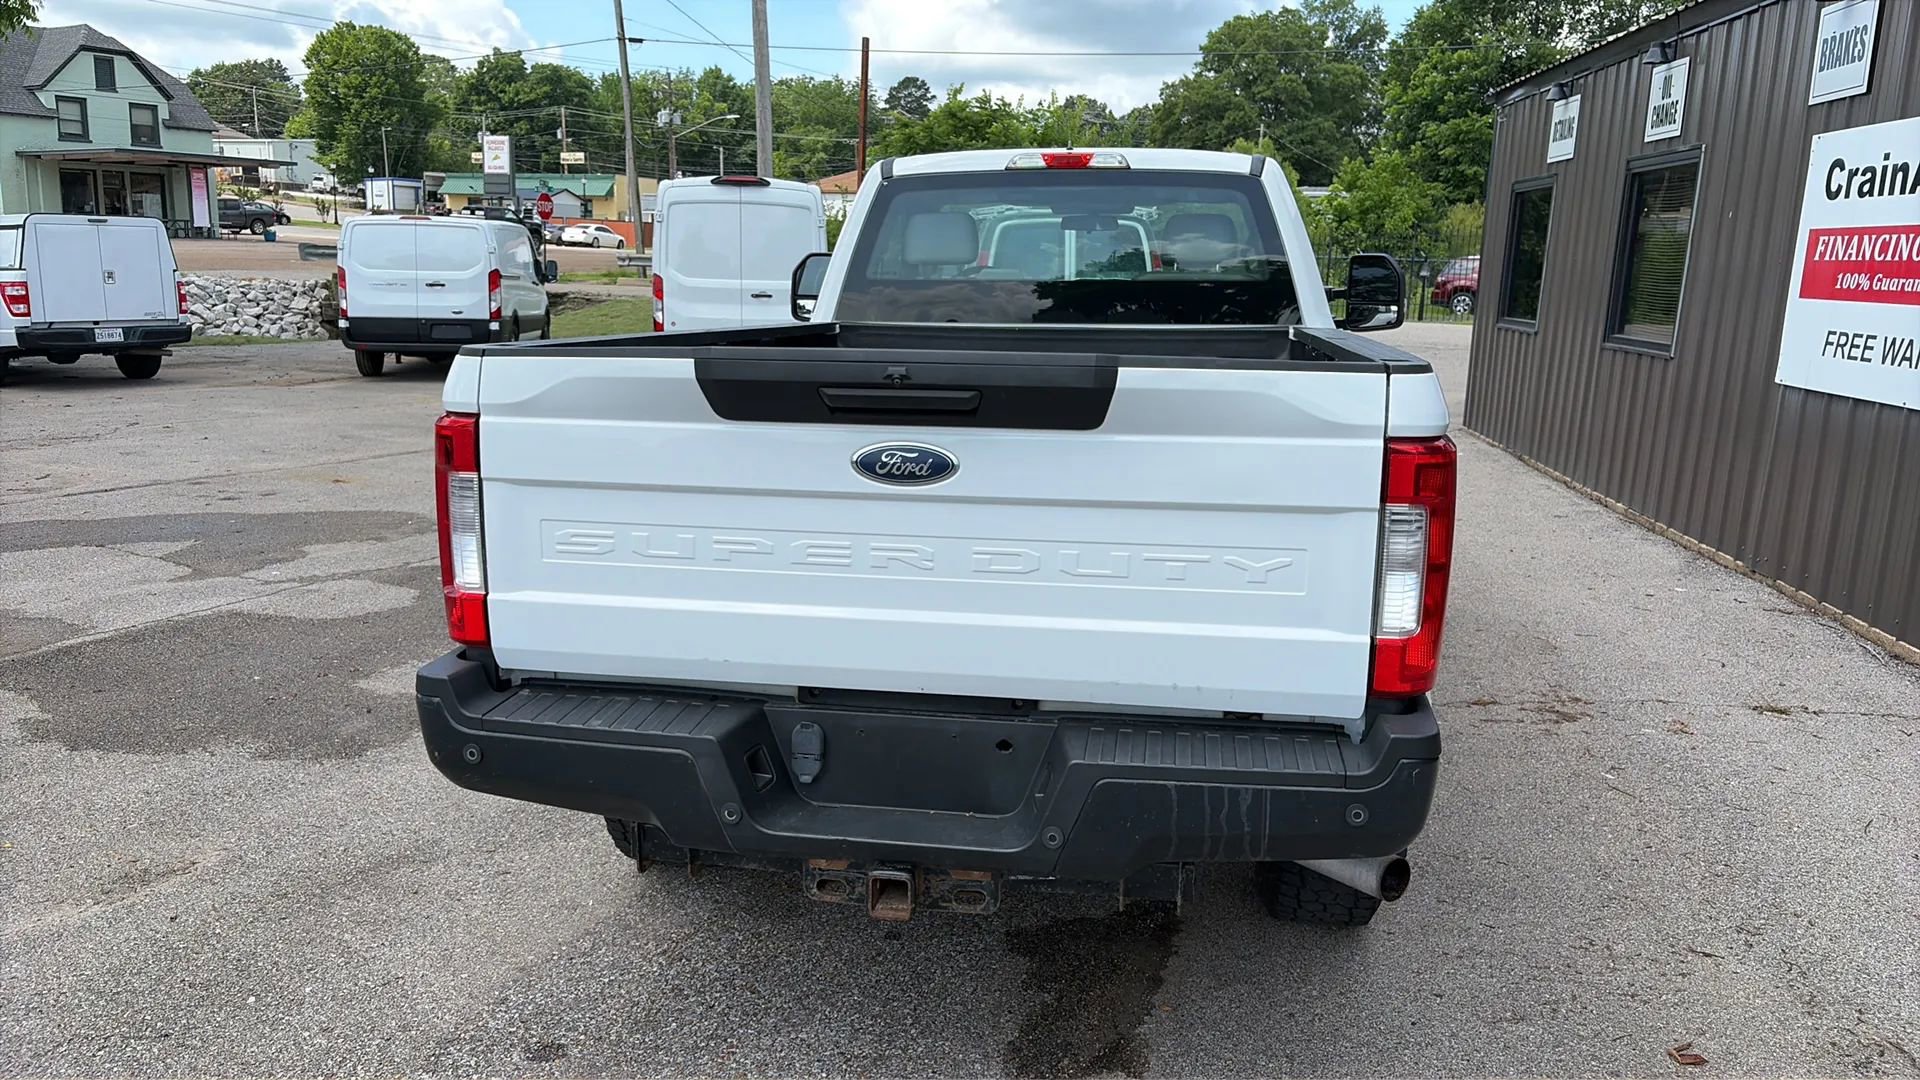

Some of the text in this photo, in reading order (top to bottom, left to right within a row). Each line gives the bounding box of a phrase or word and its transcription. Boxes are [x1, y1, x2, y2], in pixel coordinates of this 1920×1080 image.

[1818, 24, 1868, 73] BRAKES
[1661, 74, 1674, 101] OIL
[1650, 99, 1680, 130] CHANGE
[537, 201, 553, 212] STOP
[1835, 272, 1870, 291] 100%
[1821, 330, 1878, 364] FREE
[875, 450, 934, 476] Ford
[554, 528, 1294, 584] SUPER DUTY
